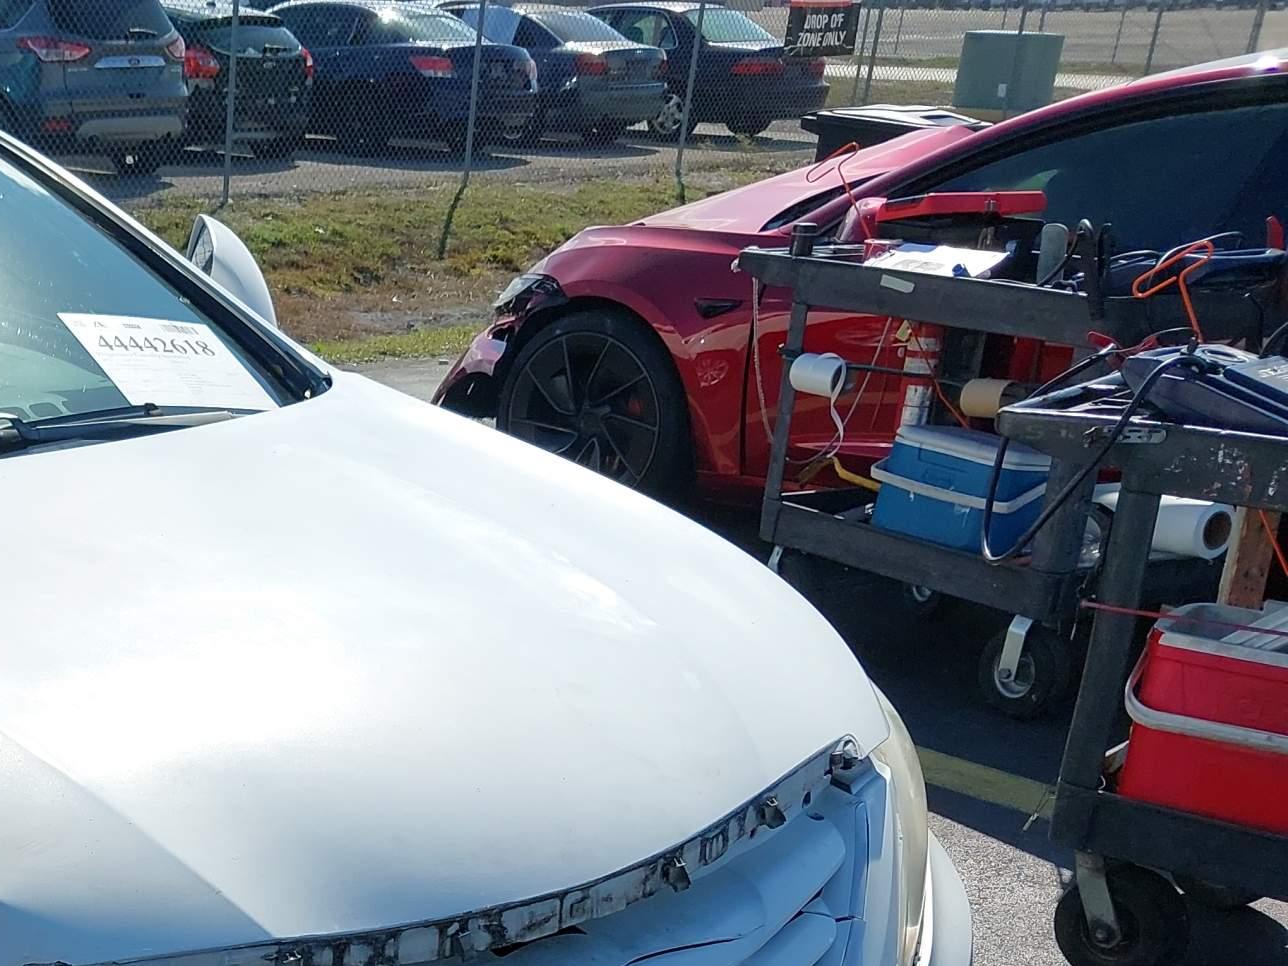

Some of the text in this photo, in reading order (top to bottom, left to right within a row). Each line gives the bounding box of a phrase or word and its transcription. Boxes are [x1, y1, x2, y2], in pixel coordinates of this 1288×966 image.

[804, 15, 829, 29] DROP
[797, 31, 847, 47] ZONE ONLY
[98, 335, 216, 356] 44442618
